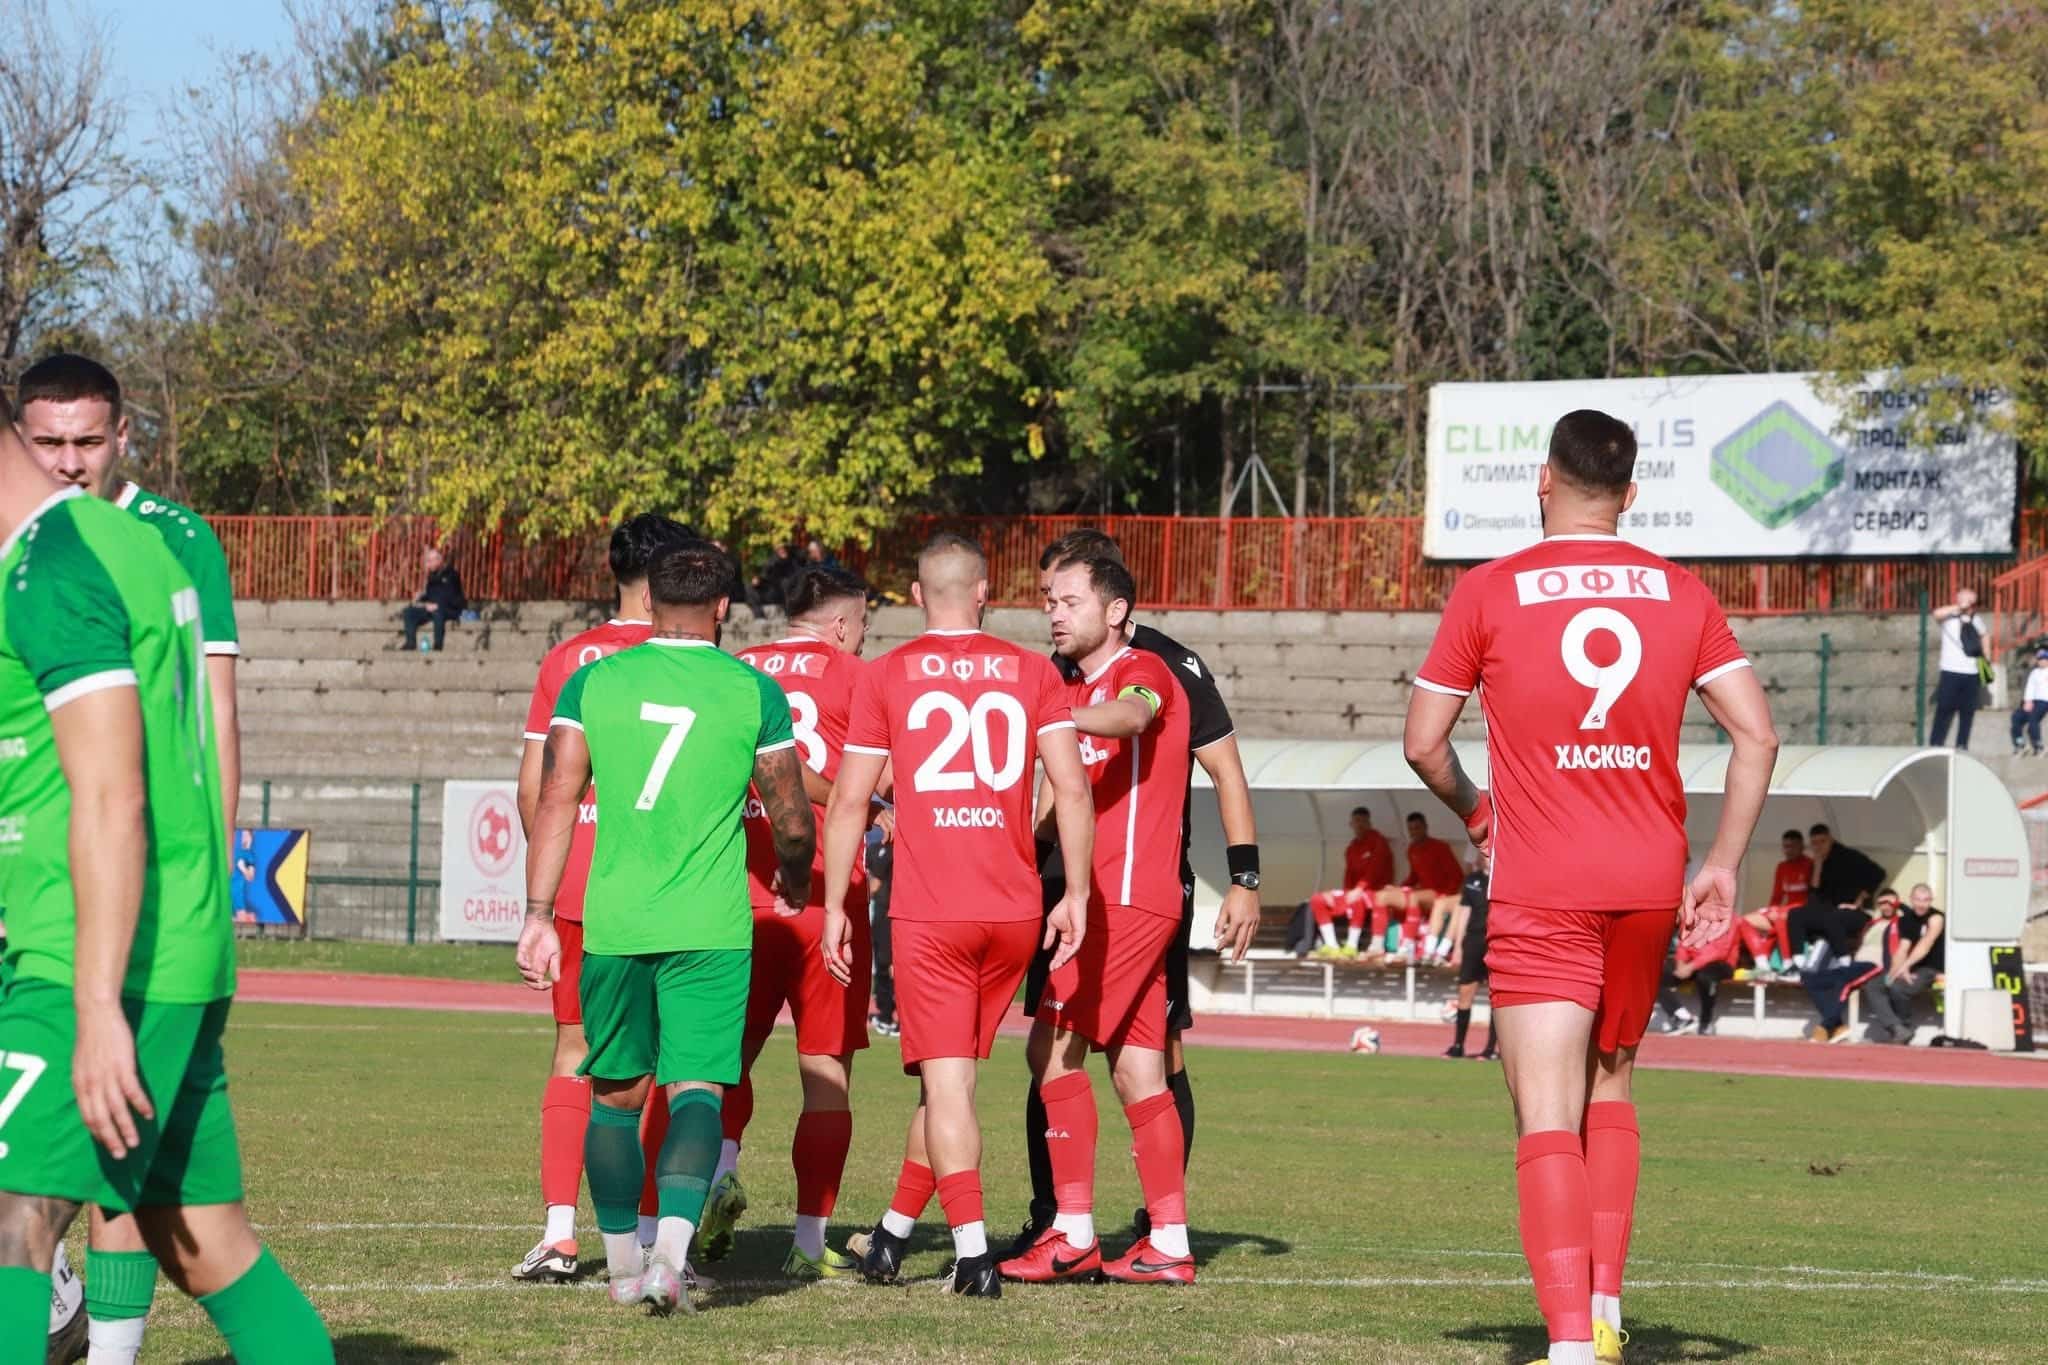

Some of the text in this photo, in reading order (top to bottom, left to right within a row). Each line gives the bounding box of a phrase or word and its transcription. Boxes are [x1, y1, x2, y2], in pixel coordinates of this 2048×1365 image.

[1445, 418, 1695, 453] CLIMLIS
[1462, 463, 1538, 483] КЛИМАТ
[1854, 469, 1942, 490] МОНТАЖ
[1653, 511, 1671, 528] 80
[1675, 511, 1693, 528] 50
[1853, 512, 1929, 531] СЕРВИЗ
[1537, 567, 1652, 597] ОФК
[920, 653, 1004, 681] ОФК
[1561, 606, 1642, 730] 9
[907, 690, 1027, 793] 20
[634, 701, 697, 811] 7
[463, 898, 521, 922] САЯНА
